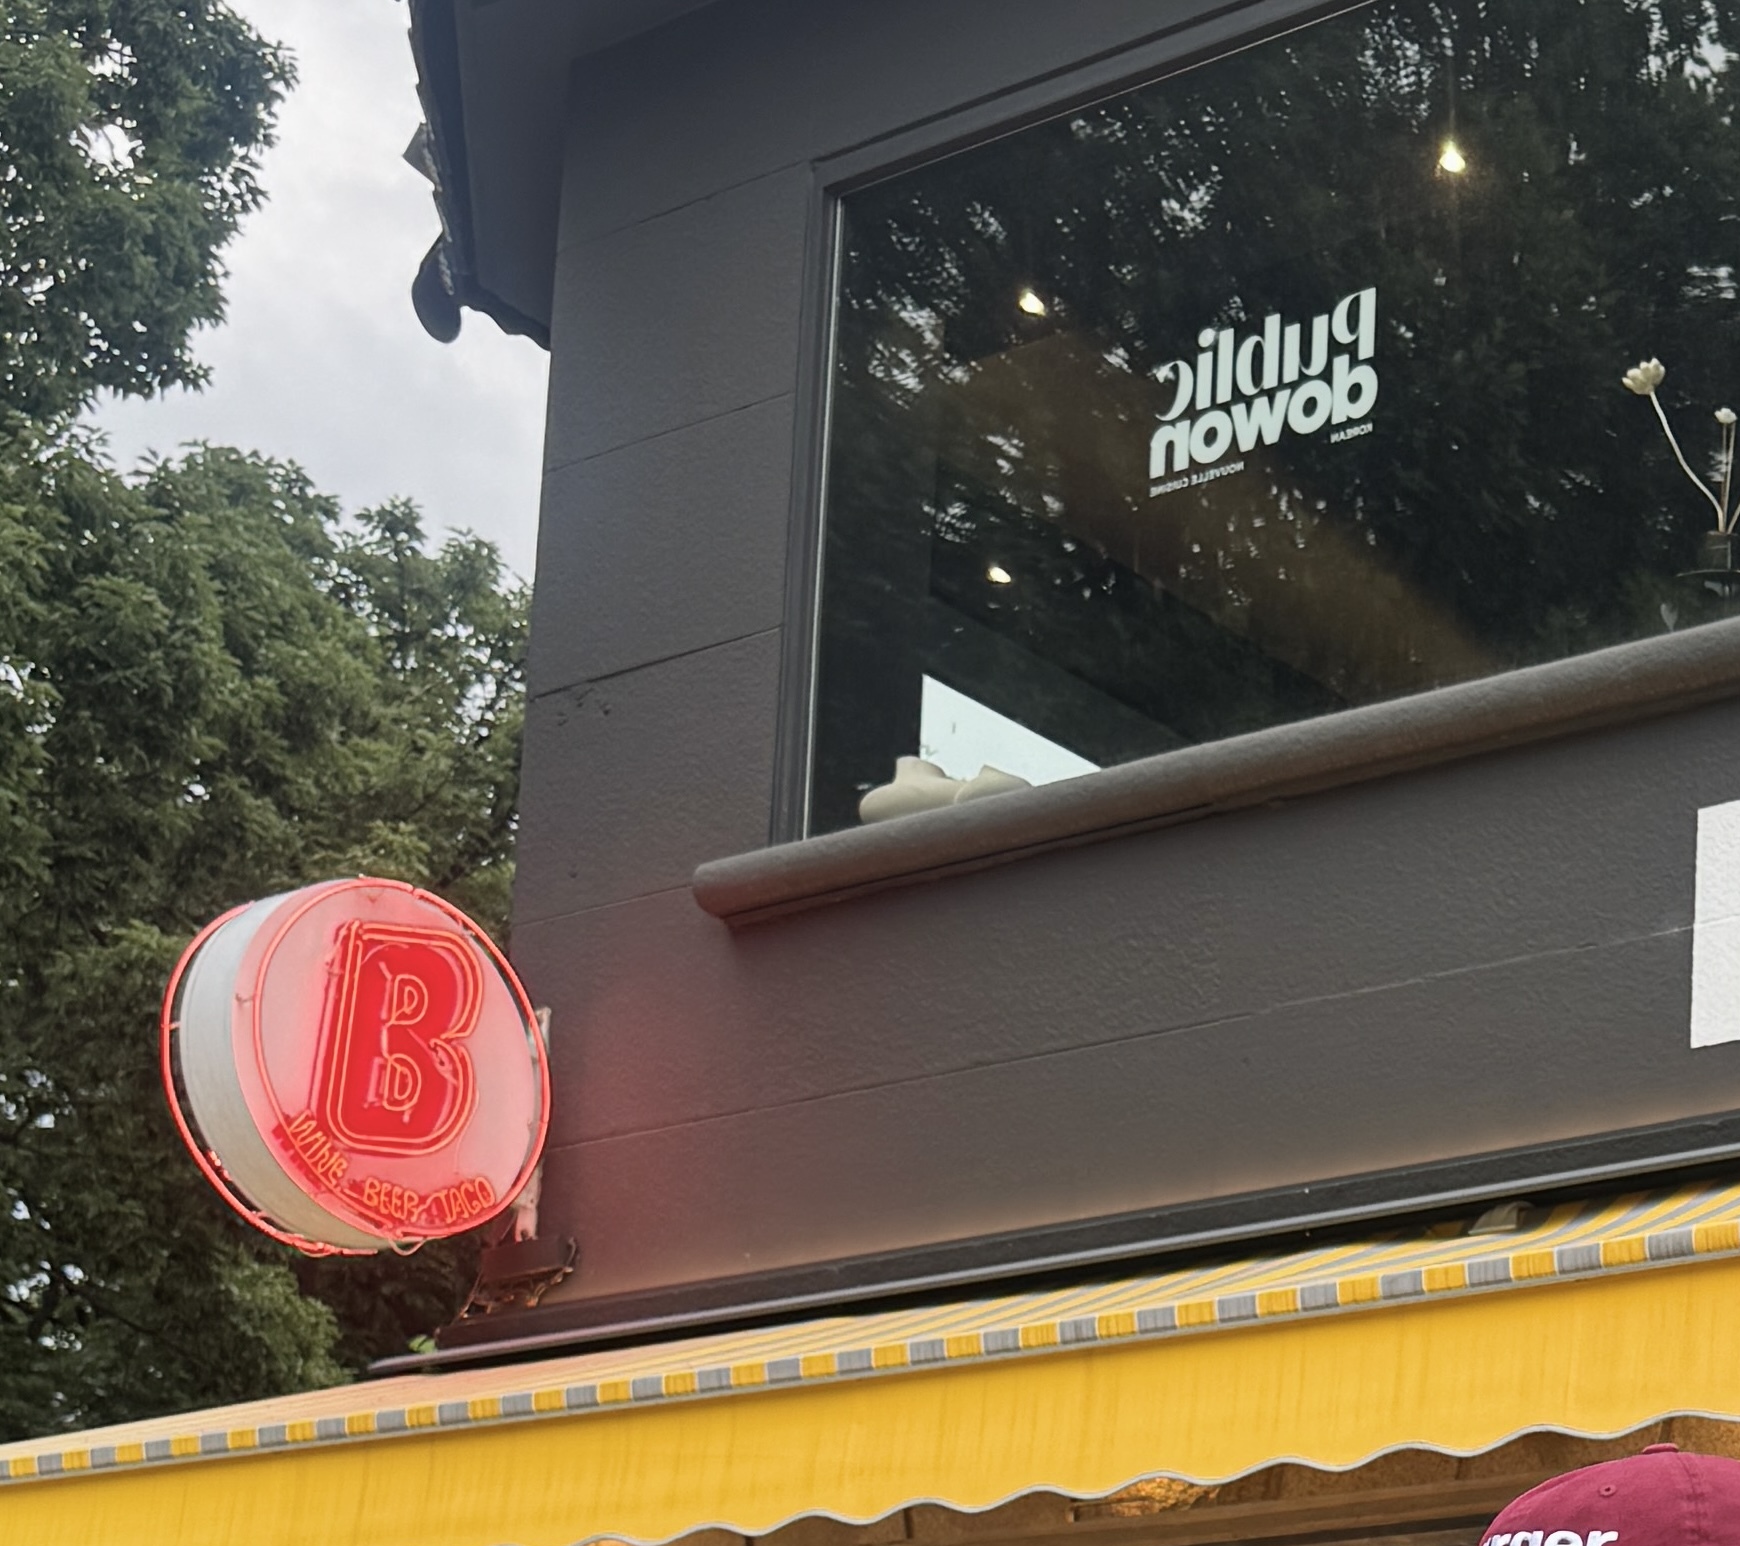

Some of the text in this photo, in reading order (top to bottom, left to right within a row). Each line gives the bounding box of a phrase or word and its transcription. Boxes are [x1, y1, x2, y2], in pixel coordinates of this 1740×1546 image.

[311, 920, 484, 1157] B
[363, 1176, 420, 1222] BEER
[438, 1176, 496, 1224] TACO
